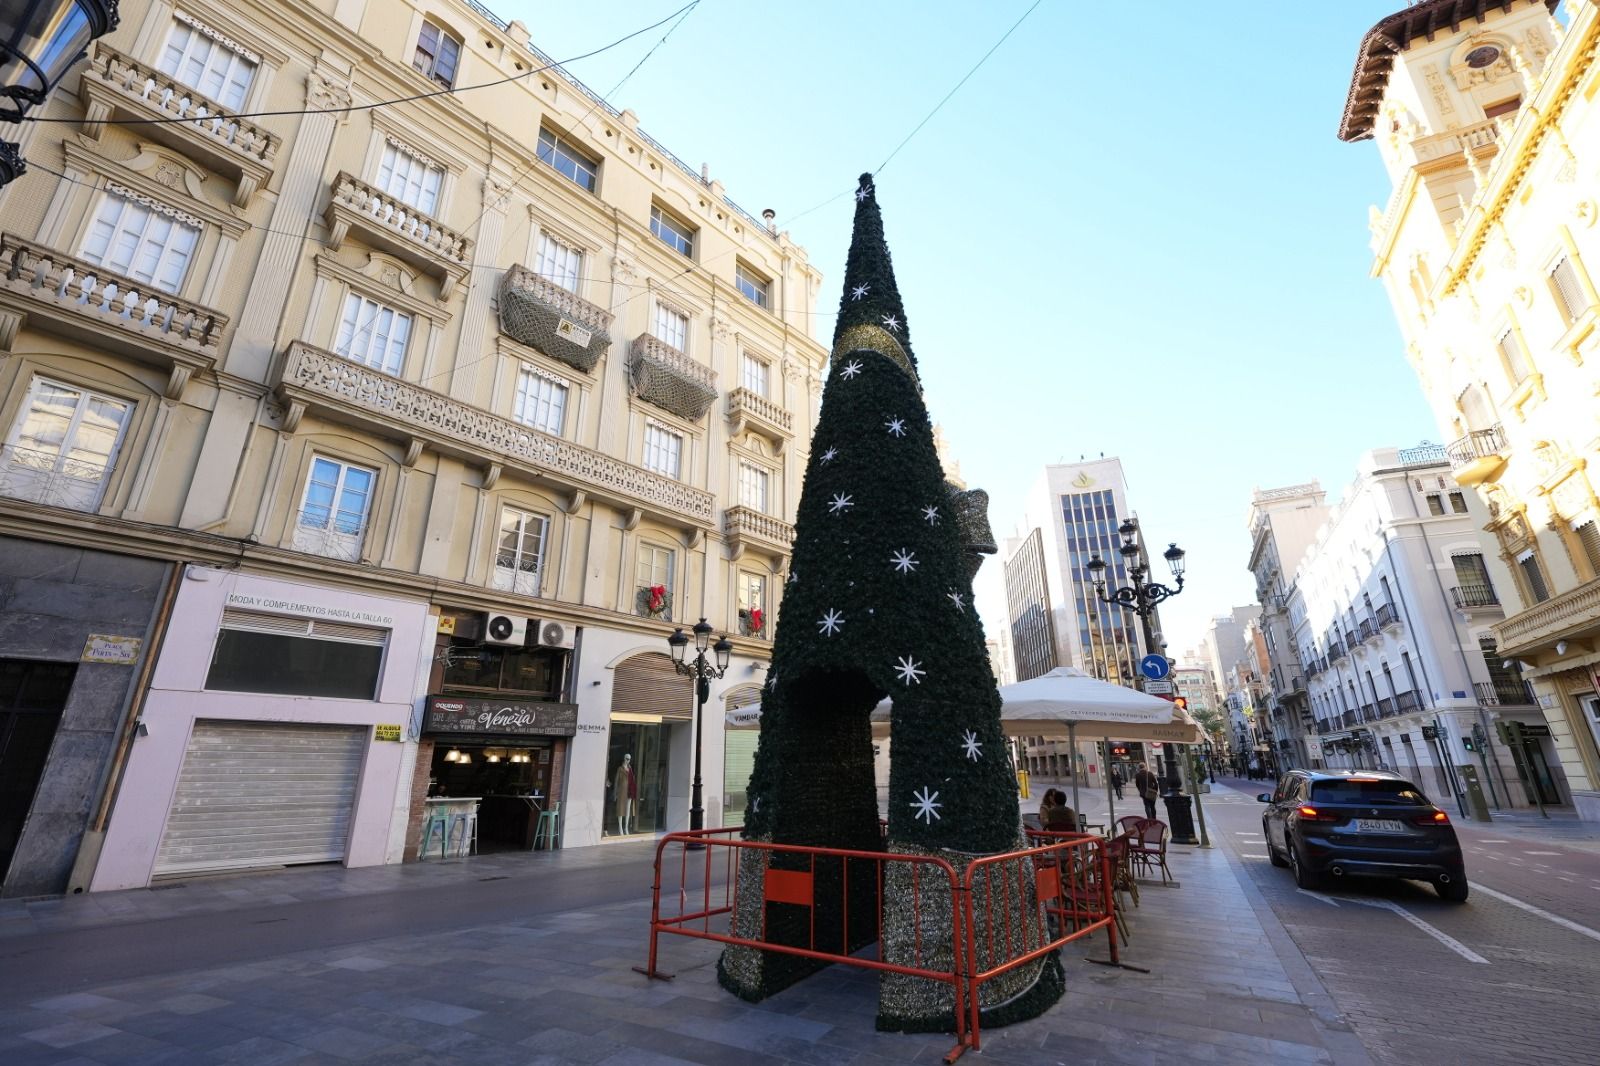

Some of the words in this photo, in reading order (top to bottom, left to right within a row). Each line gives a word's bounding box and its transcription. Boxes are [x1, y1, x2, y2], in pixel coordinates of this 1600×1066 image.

[229, 594, 254, 605] MODA
[256, 597, 262, 606] Y
[263, 599, 326, 615] COMPLEMENTOS
[327, 608, 350, 619] HASTA
[351, 612, 361, 620] LA
[362, 613, 382, 623] TALLA
[478, 707, 536, 729] Venezia
[1359, 821, 1381, 829] 2840
[1383, 821, 1401, 830] LYN
